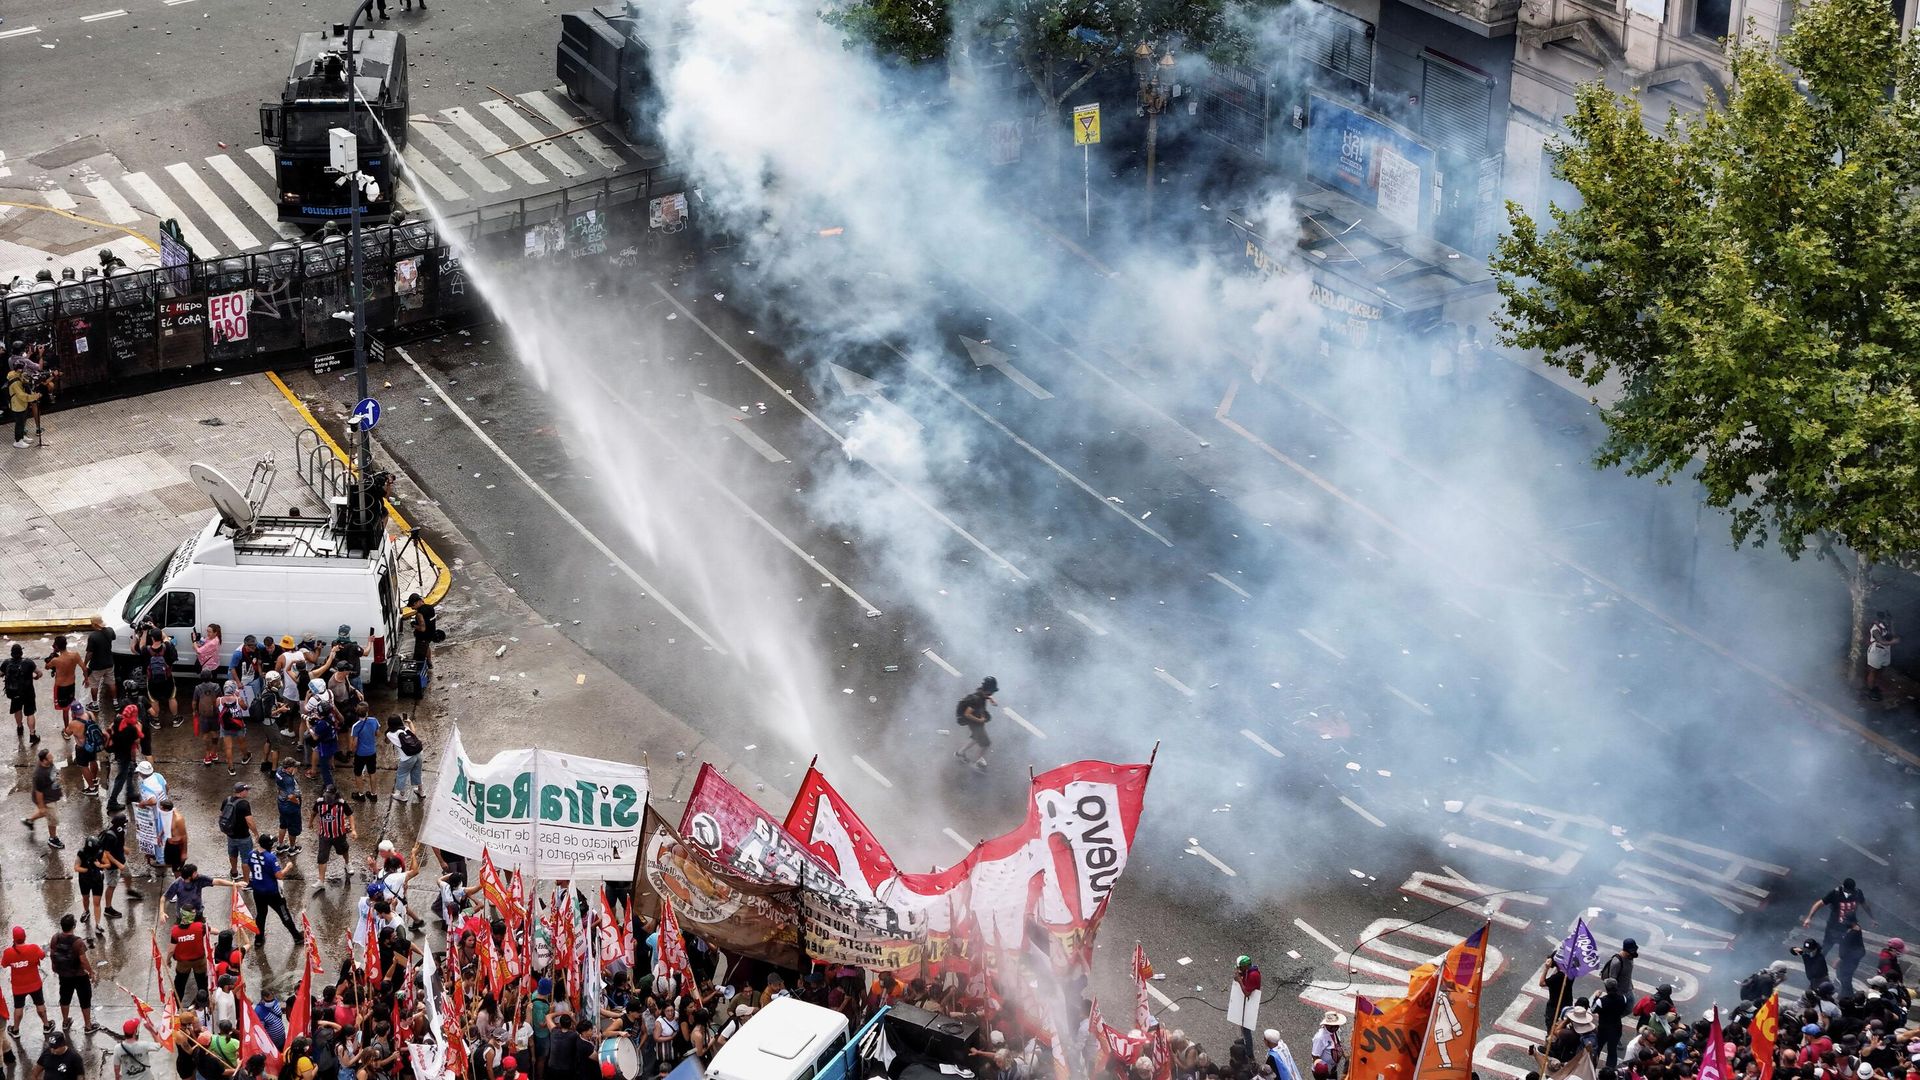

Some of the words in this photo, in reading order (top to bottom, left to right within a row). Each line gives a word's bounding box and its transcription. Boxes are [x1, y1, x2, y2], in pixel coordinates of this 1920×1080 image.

[302, 206, 333, 215] POLICIA
[334, 206, 368, 215] FEDEAL
[176, 302, 203, 312] MIEDO
[210, 294, 244, 321] EFO
[314, 355, 335, 363] Avenida
[254, 864, 263, 881] 8
[178, 933, 195, 943] mas
